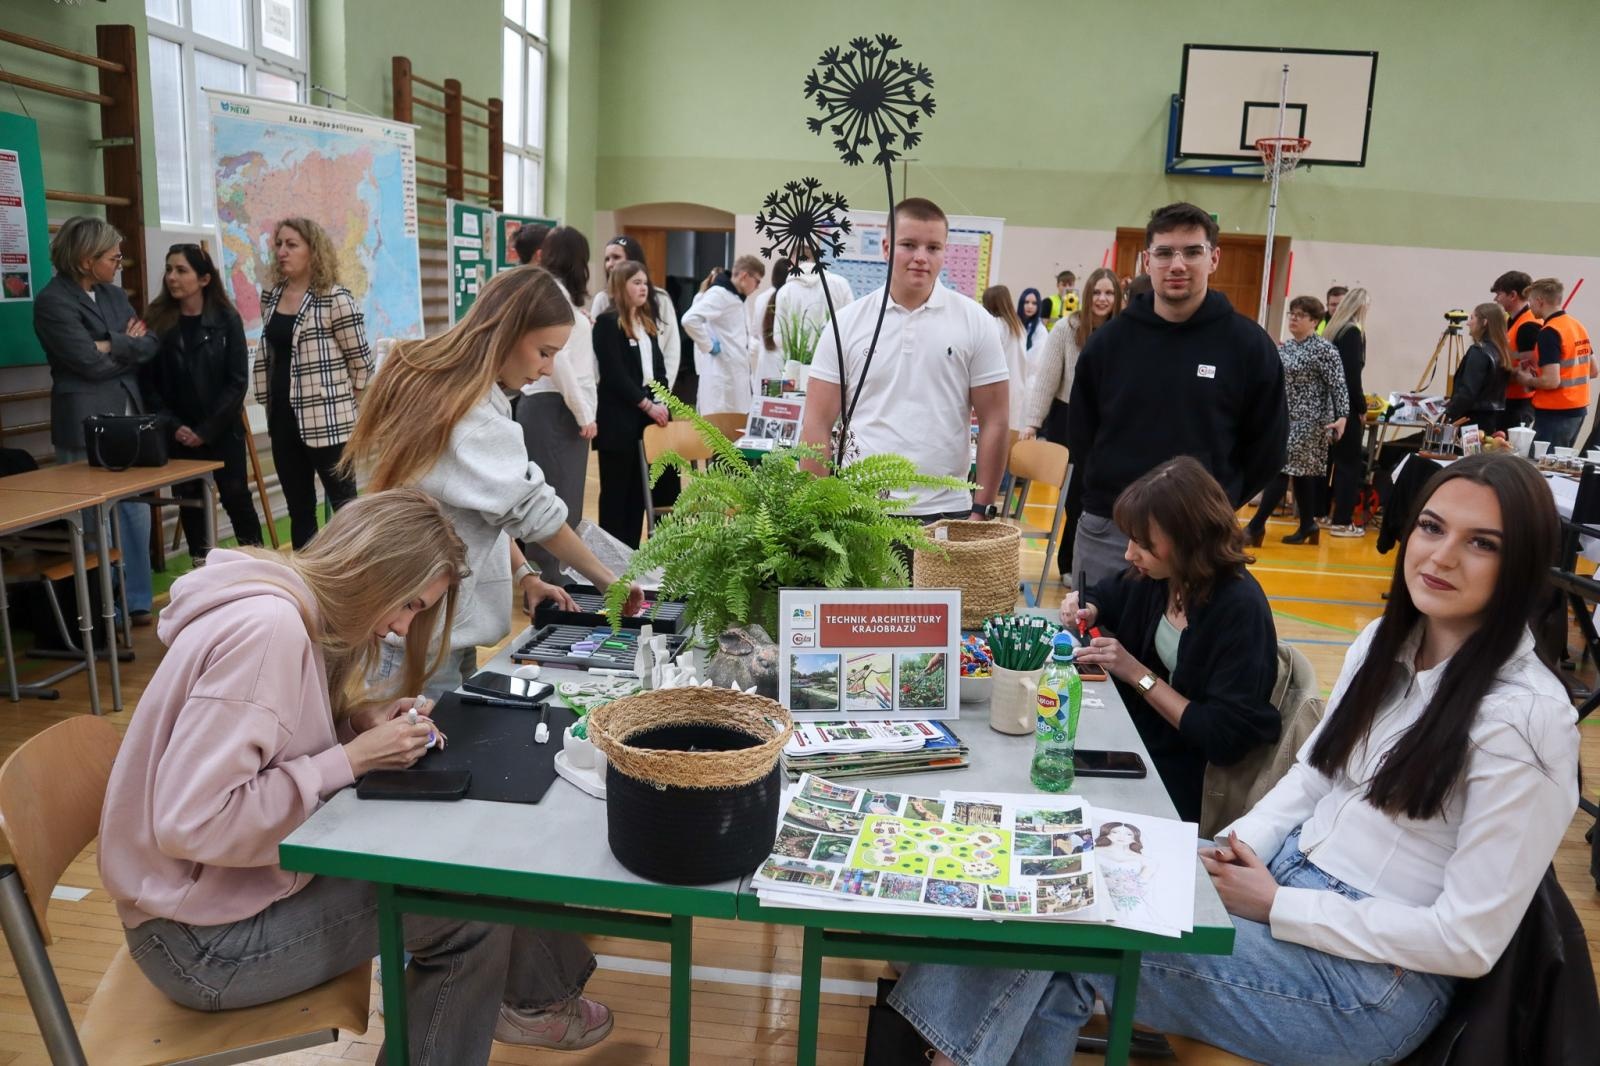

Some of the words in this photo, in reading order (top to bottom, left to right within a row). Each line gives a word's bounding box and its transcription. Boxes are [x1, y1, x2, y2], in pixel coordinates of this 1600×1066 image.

[288, 114, 307, 124] AZJA
[313, 120, 330, 129] mapa
[331, 123, 364, 134] polityczna
[826, 615, 867, 624] TECHNIK
[870, 615, 942, 624] ARCHITEKTURY
[852, 624, 916, 633] KRAJOBRAZU
